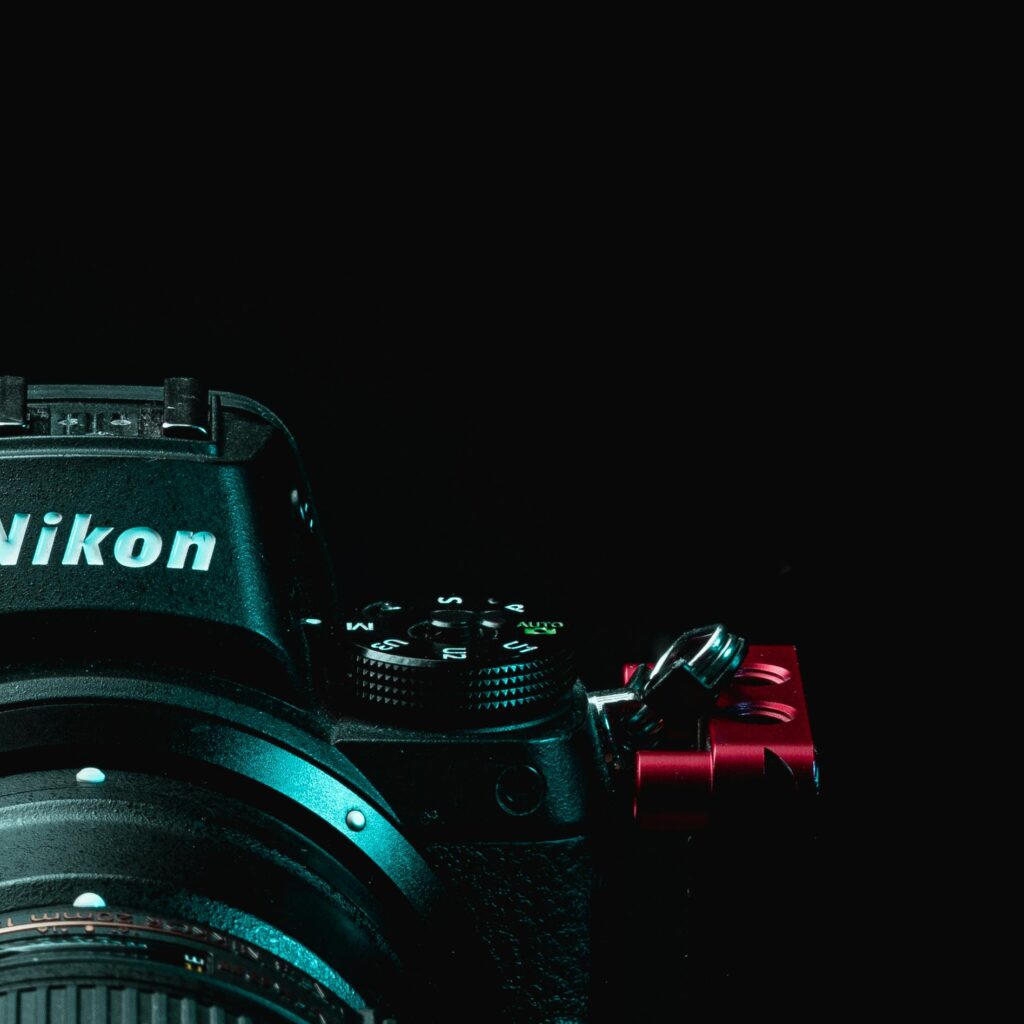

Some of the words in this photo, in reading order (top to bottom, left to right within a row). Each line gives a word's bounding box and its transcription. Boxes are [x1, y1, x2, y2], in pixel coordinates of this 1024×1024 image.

[436, 595, 464, 605] S
[345, 621, 375, 632] M
[370, 638, 410, 652] U3
[501, 640, 539, 654] U1
[441, 646, 468, 661] U2
